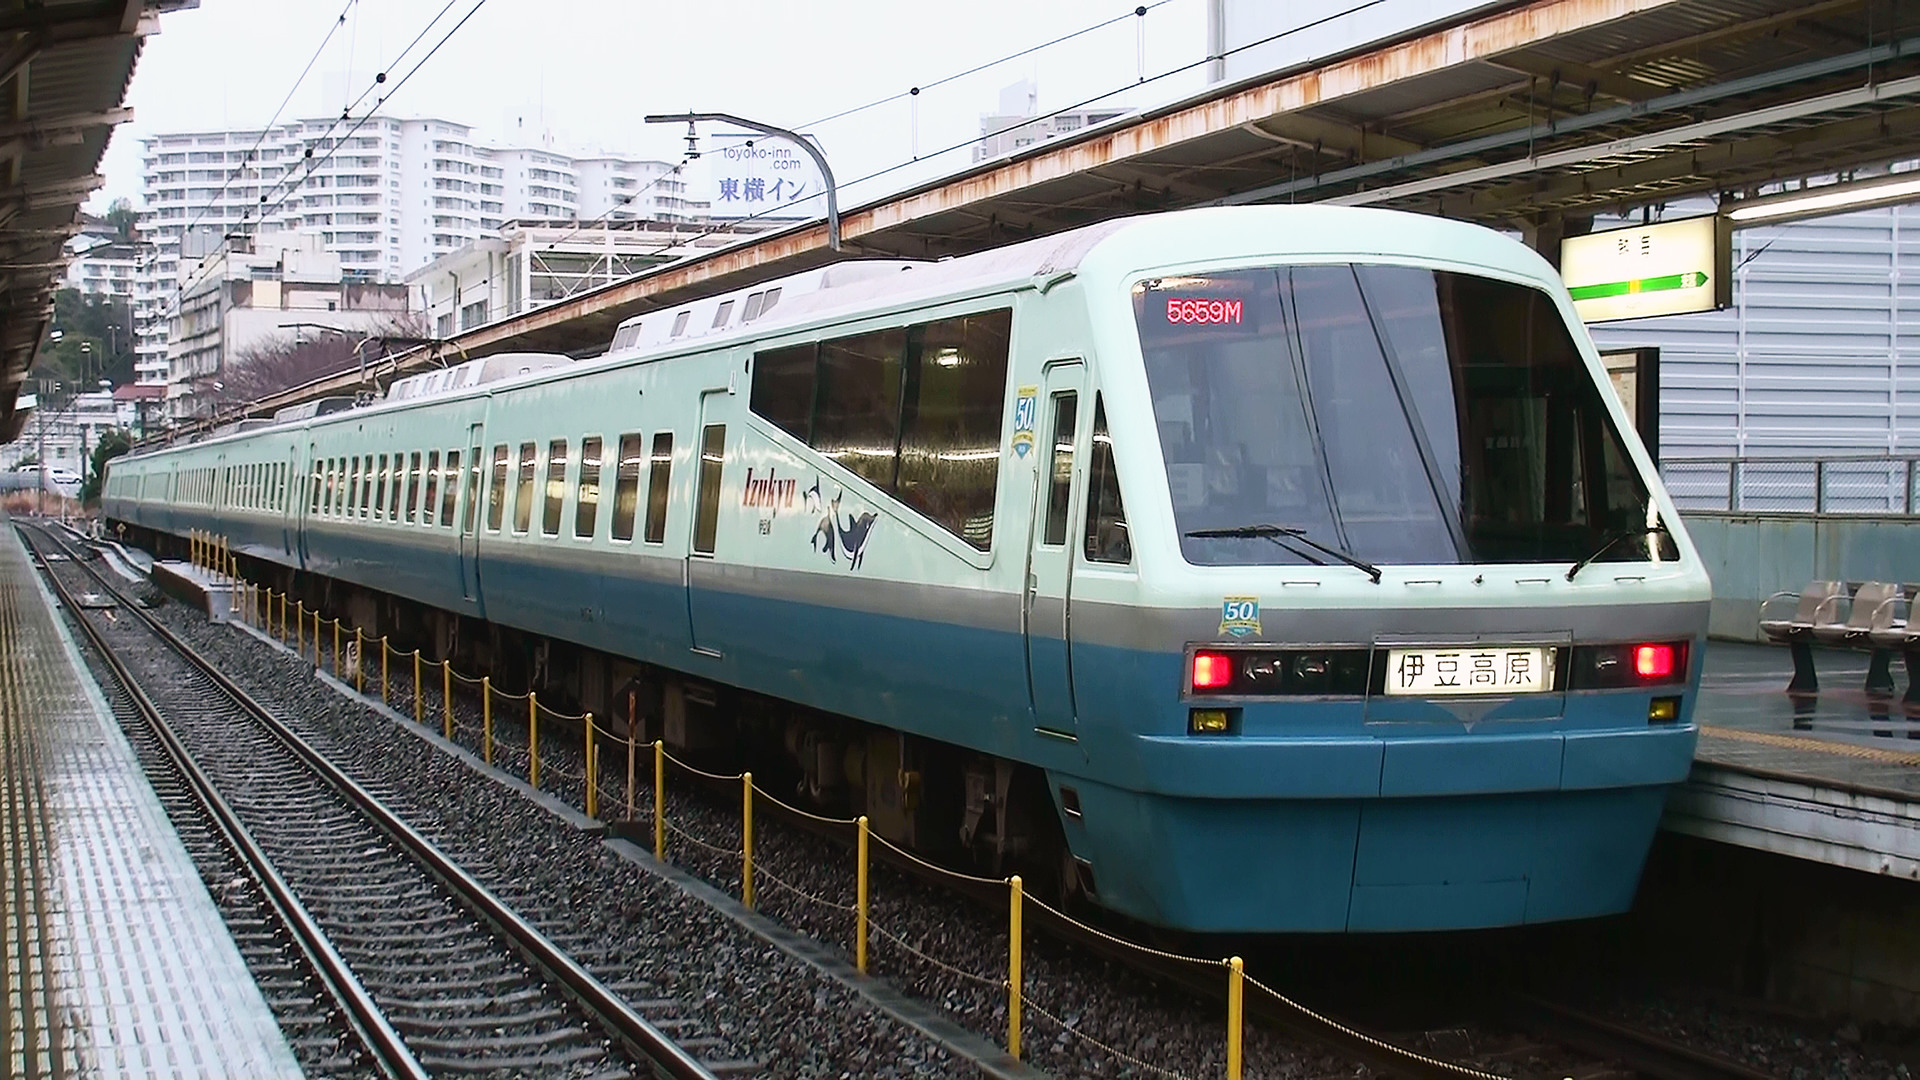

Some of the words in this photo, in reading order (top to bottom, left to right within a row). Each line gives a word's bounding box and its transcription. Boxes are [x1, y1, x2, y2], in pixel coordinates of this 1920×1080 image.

[723, 147, 792, 162] toyoko-inn
[769, 158, 801, 170] .com
[717, 176, 807, 203] 東横イン
[1167, 299, 1242, 324] 5659M
[742, 467, 796, 518] Izukyu
[1397, 651, 1532, 688] 伊豆高原
